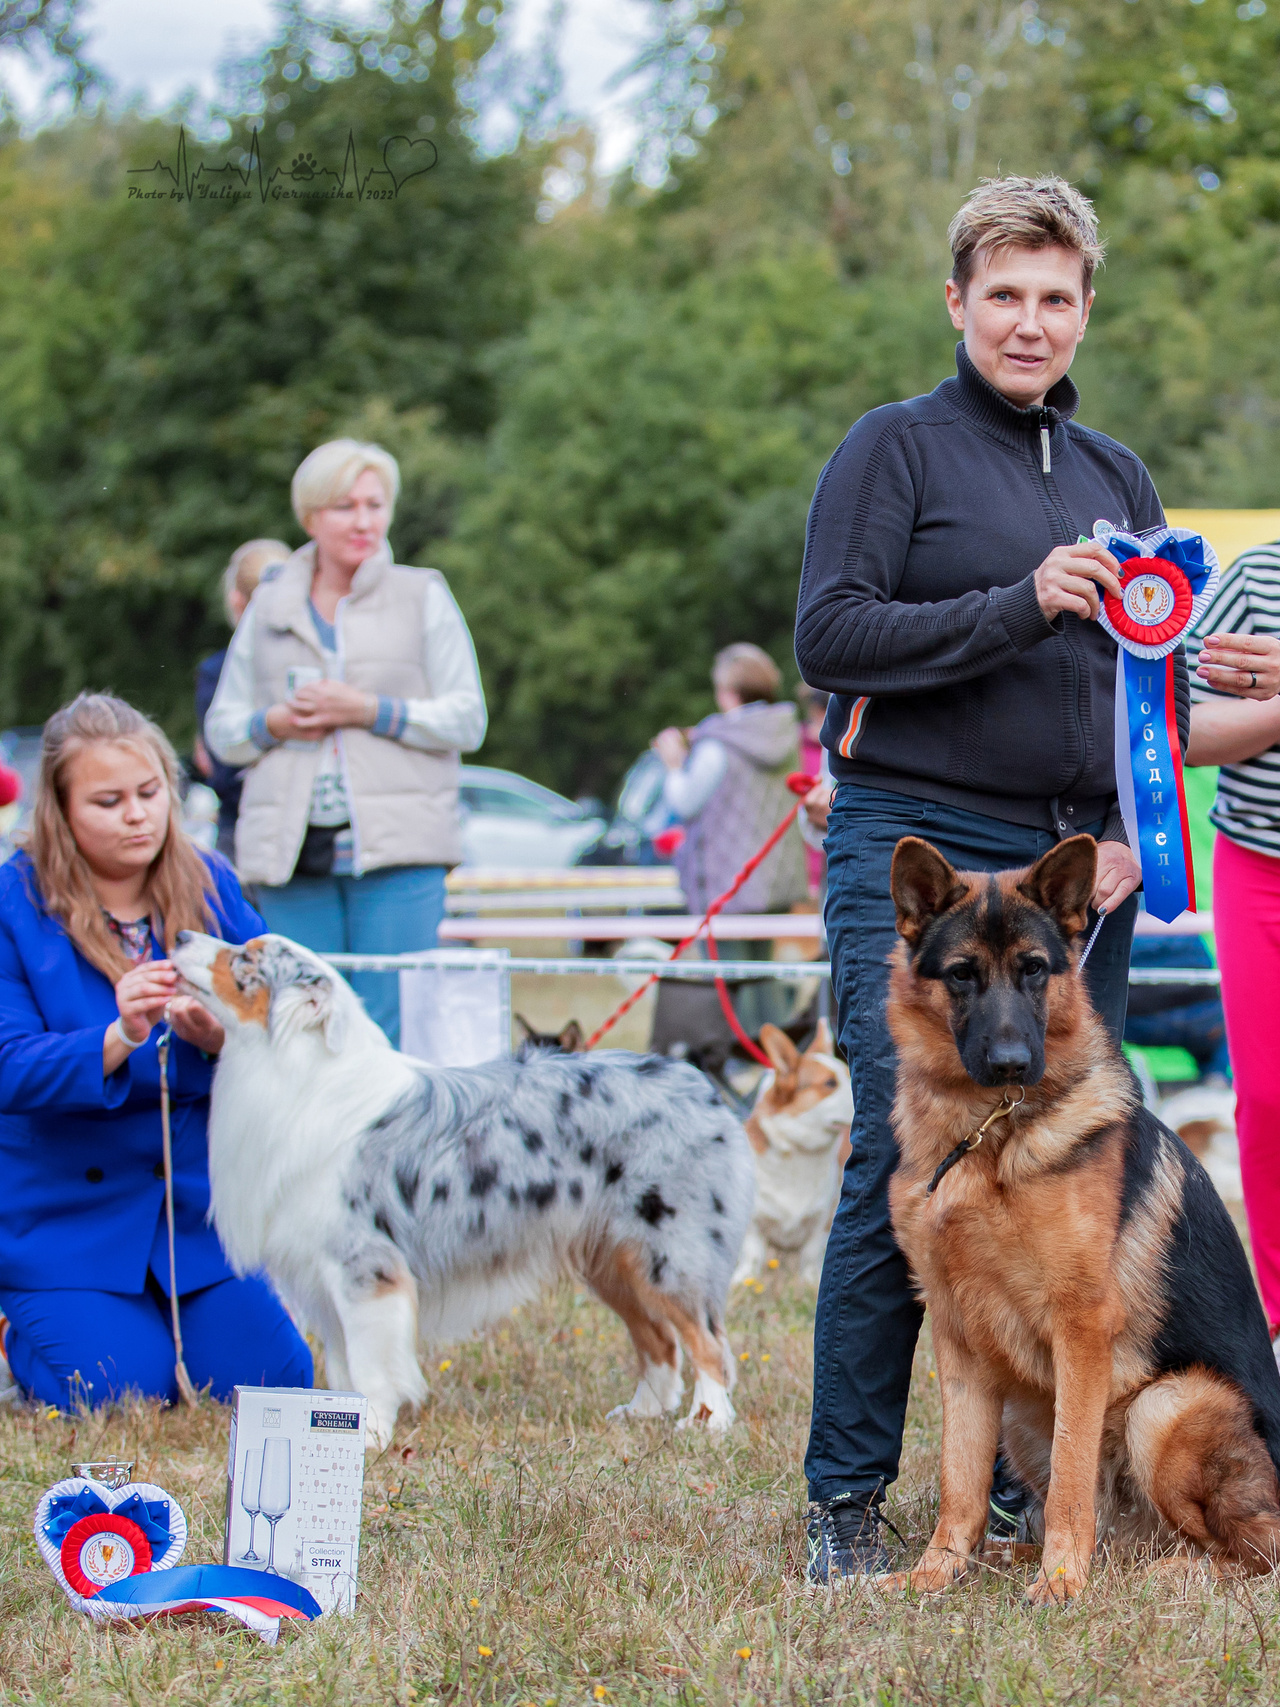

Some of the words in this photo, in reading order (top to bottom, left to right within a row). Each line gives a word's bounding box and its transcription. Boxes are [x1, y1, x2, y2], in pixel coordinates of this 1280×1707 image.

[1137, 675, 1172, 888] Победитель
[313, 1411, 357, 1421] CRYSTALITE
[317, 1419, 353, 1428] BOHEMIA
[309, 1546, 346, 1556] Collection
[311, 1557, 342, 1568] STRIX
